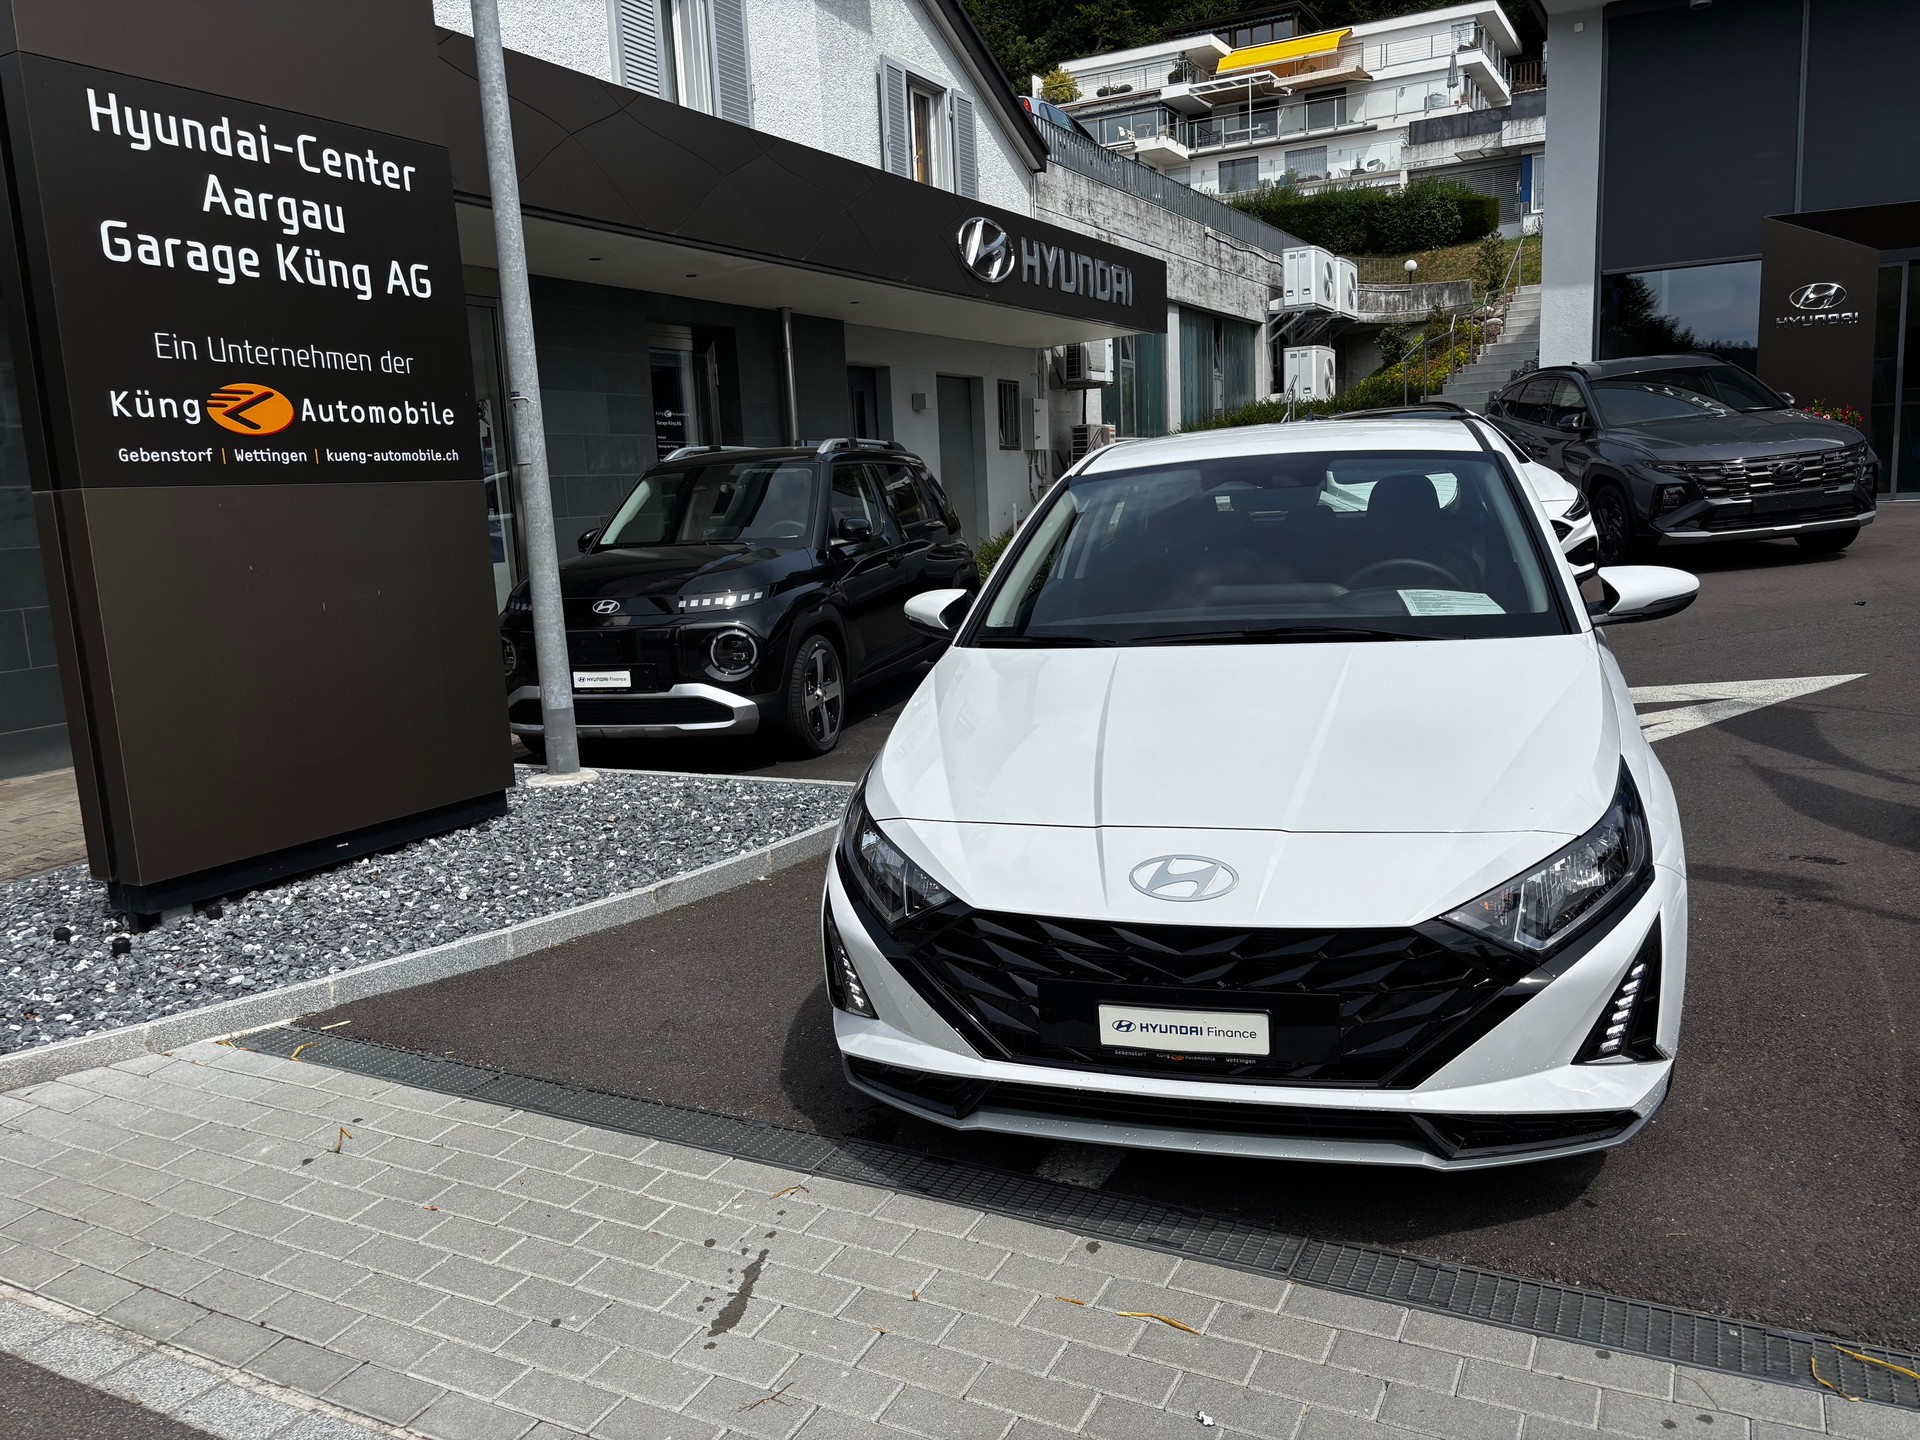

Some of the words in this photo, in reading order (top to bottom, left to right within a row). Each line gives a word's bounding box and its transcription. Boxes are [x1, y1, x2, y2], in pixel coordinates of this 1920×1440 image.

[86, 88, 416, 192] Hyundai-Center
[202, 173, 345, 236] Aargau
[99, 219, 260, 286] Garage
[275, 243, 372, 301] Küng
[386, 260, 432, 299] AG
[1020, 237, 1133, 307] HYUNDAI
[1775, 312, 1859, 328] HYUNDAI
[154, 332, 198, 361] Ein
[207, 336, 372, 372] Unternehmen
[380, 350, 414, 375] der
[109, 389, 201, 425] Küng
[301, 397, 455, 426] Automobile
[118, 447, 213, 463] Gebenstorf
[234, 448, 308, 465] Wettingen
[326, 448, 459, 463] kueng-automobile.ch
[1140, 1022, 1203, 1036] HYUNDAI
[1207, 1026, 1257, 1039] Finance
[1114, 1049, 1147, 1057] Gebenstorf
